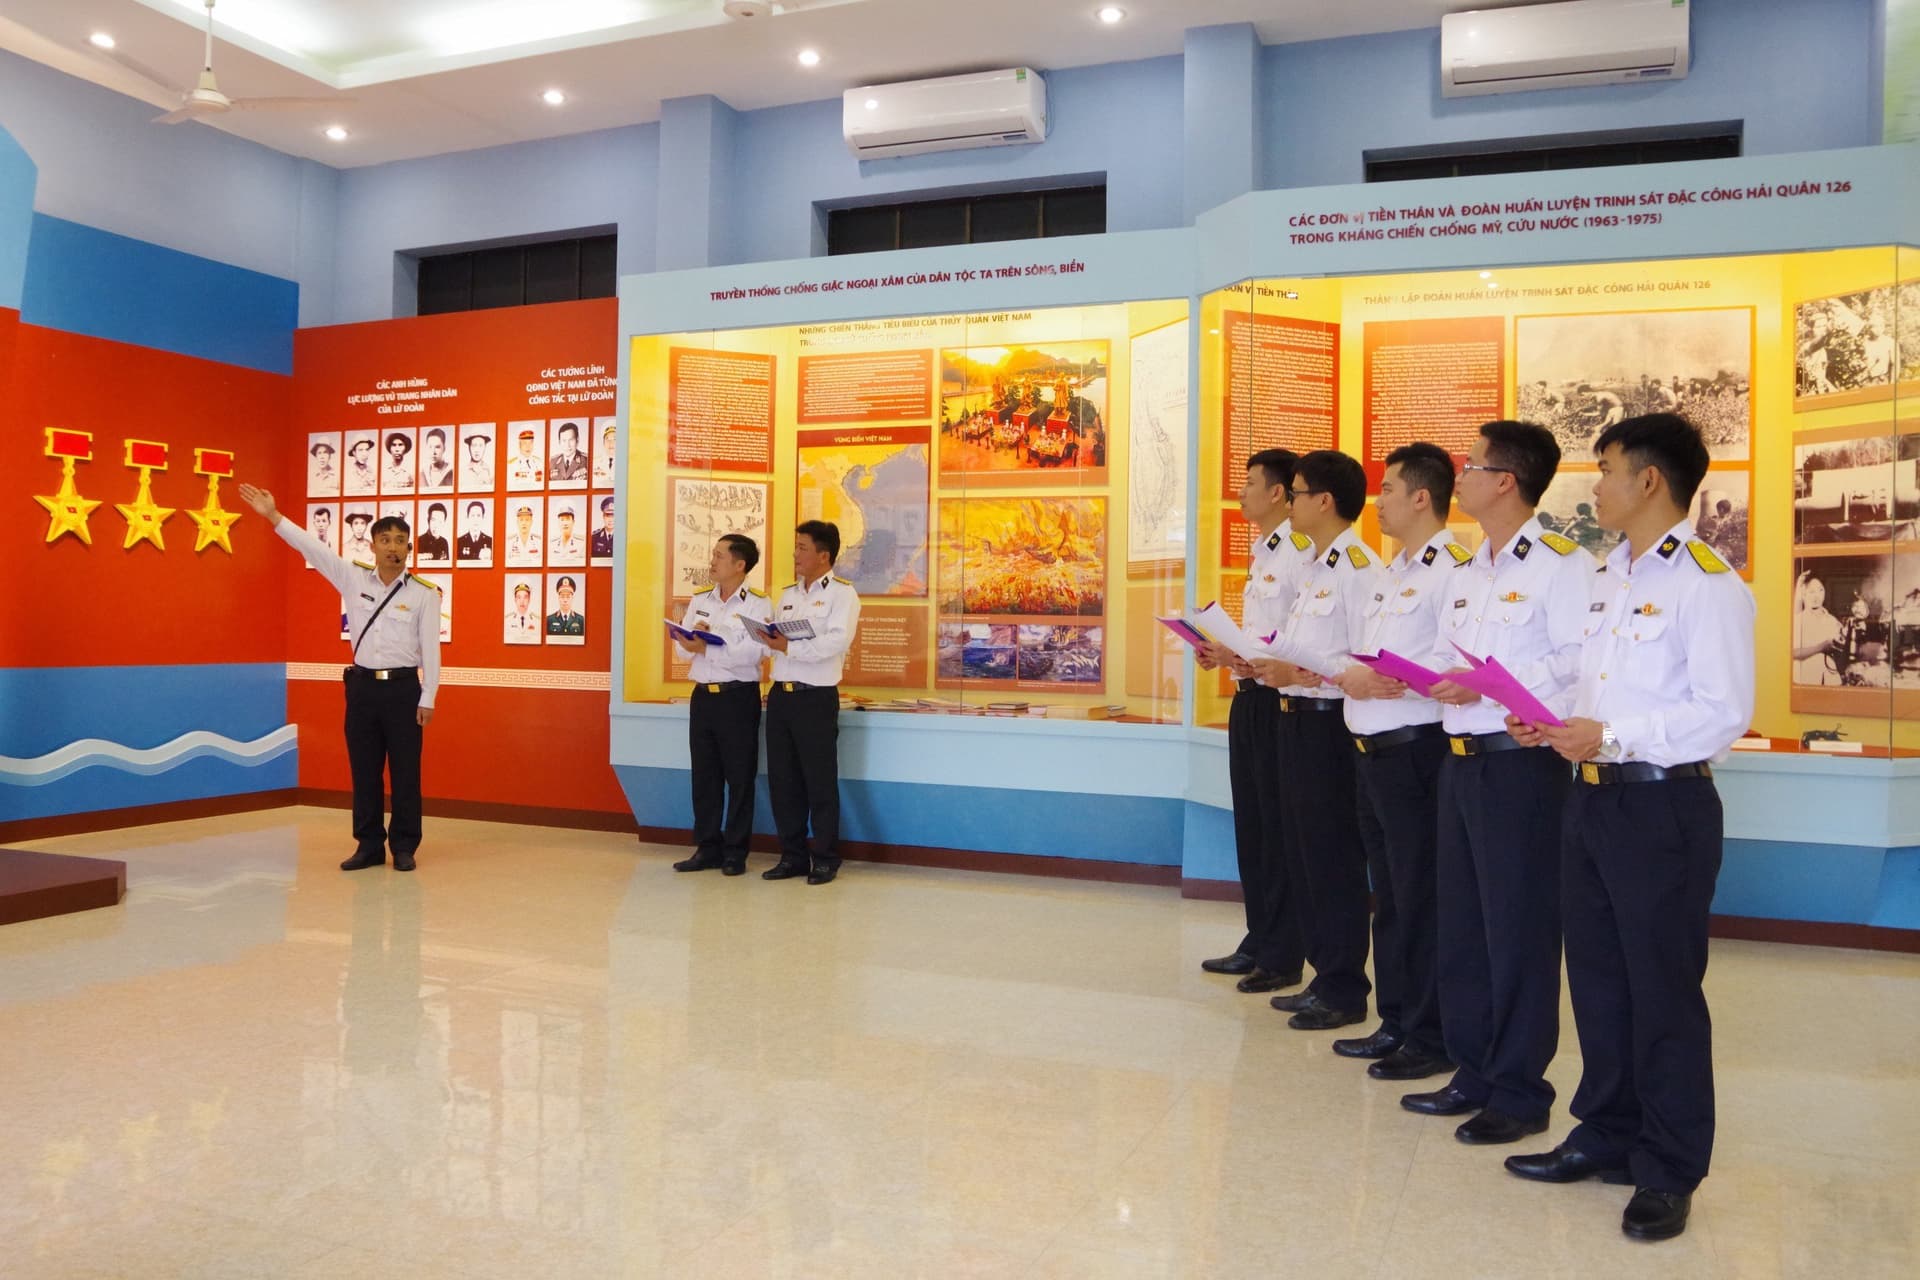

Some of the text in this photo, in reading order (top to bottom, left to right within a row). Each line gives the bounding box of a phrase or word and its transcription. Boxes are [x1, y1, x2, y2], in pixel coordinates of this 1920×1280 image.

[1289, 213, 1315, 227] CÁC
[1319, 212, 1348, 225] ĐƠN
[1368, 206, 1395, 222] TIỀN
[1400, 206, 1434, 220] THÂN
[1439, 205, 1455, 217] VÀ
[1461, 202, 1500, 216] ĐOÀN
[1505, 197, 1543, 213] HUẤN
[1547, 196, 1590, 212] LUYỆN
[1594, 195, 1635, 208] TRINH
[1639, 191, 1664, 205] SÁT
[1668, 189, 1696, 205] ĐẶC
[1701, 187, 1743, 202] CÔNG
[1747, 184, 1772, 199] HẢI
[1776, 181, 1820, 197] QUÂN
[1826, 181, 1851, 193] 126
[1290, 232, 1334, 244] TRONG
[1339, 228, 1384, 242] KHÁNG
[1387, 223, 1424, 239] CHIẾN
[1429, 221, 1476, 237] CHỐNG
[1482, 221, 1502, 234] MỸ,
[1507, 218, 1535, 232] CỨU
[1540, 215, 1578, 230] NƯỚC
[710, 287, 746, 301] TRUYỀN
[749, 284, 780, 297] THỐNG
[784, 281, 818, 295] CHỐNG
[822, 280, 843, 293] GIẶC
[847, 278, 878, 290] NGOẠI
[881, 275, 904, 286] XÂM
[907, 273, 926, 285] CỦA
[929, 271, 950, 283] DÂN
[955, 270, 976, 282] TỘC
[980, 269, 992, 279] TA
[995, 266, 1021, 278] TRÊN
[1060, 259, 1084, 273] BIỂN
[1276, 289, 1298, 300] TH
[1364, 294, 1398, 305] THÀN
[1694, 280, 1710, 289] 126
[992, 312, 1009, 323] VIỆT
[1012, 312, 1032, 321] NAM
[541, 368, 556, 378] CÁC
[376, 379, 390, 389] CÁC
[392, 380, 406, 389] ANH
[550, 380, 566, 391] VIỆT
[568, 380, 586, 389] NAM
[528, 394, 550, 405] CÔNG
[552, 393, 565, 403] TÁC
[567, 394, 578, 404] TẠI
[591, 389, 613, 400] ĐOÀN
